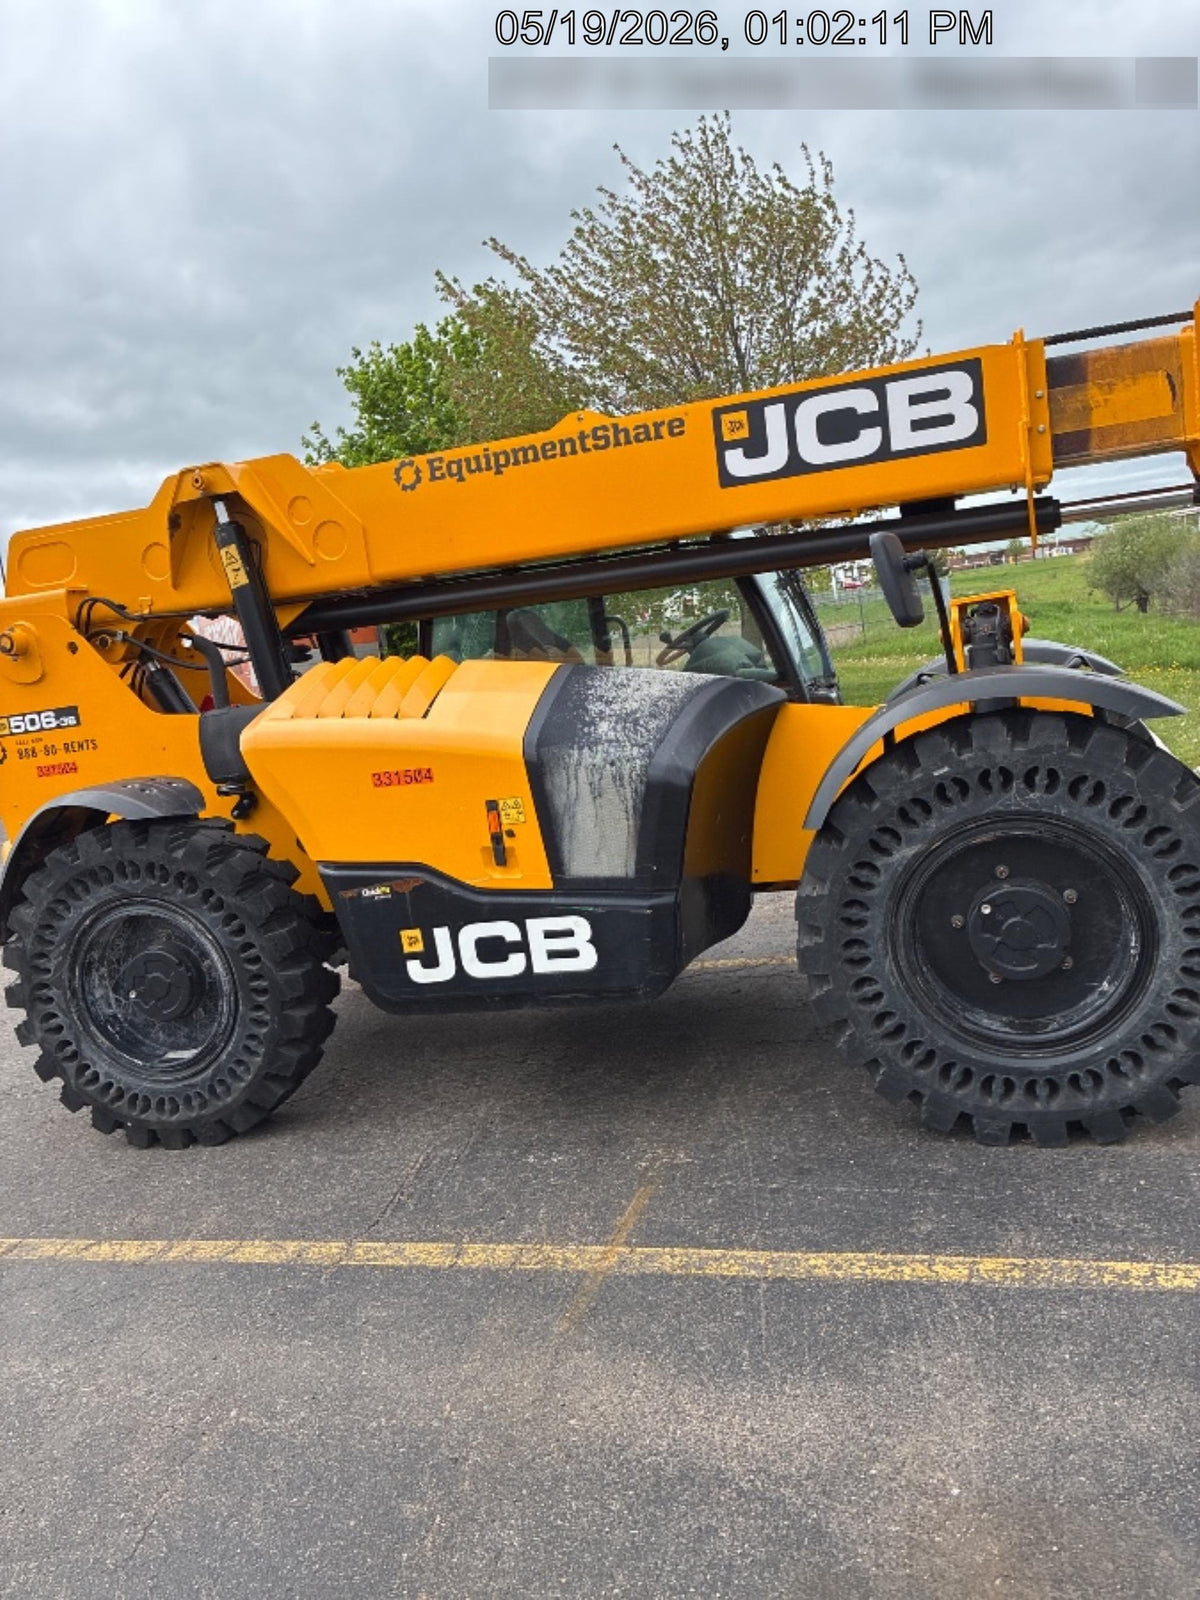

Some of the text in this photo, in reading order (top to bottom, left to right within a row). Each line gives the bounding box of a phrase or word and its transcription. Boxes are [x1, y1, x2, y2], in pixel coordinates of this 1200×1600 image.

[426, 414, 686, 483] EquipmentShare
[723, 369, 980, 479] JCB
[372, 768, 434, 788] 331504
[406, 915, 599, 984] JCB
